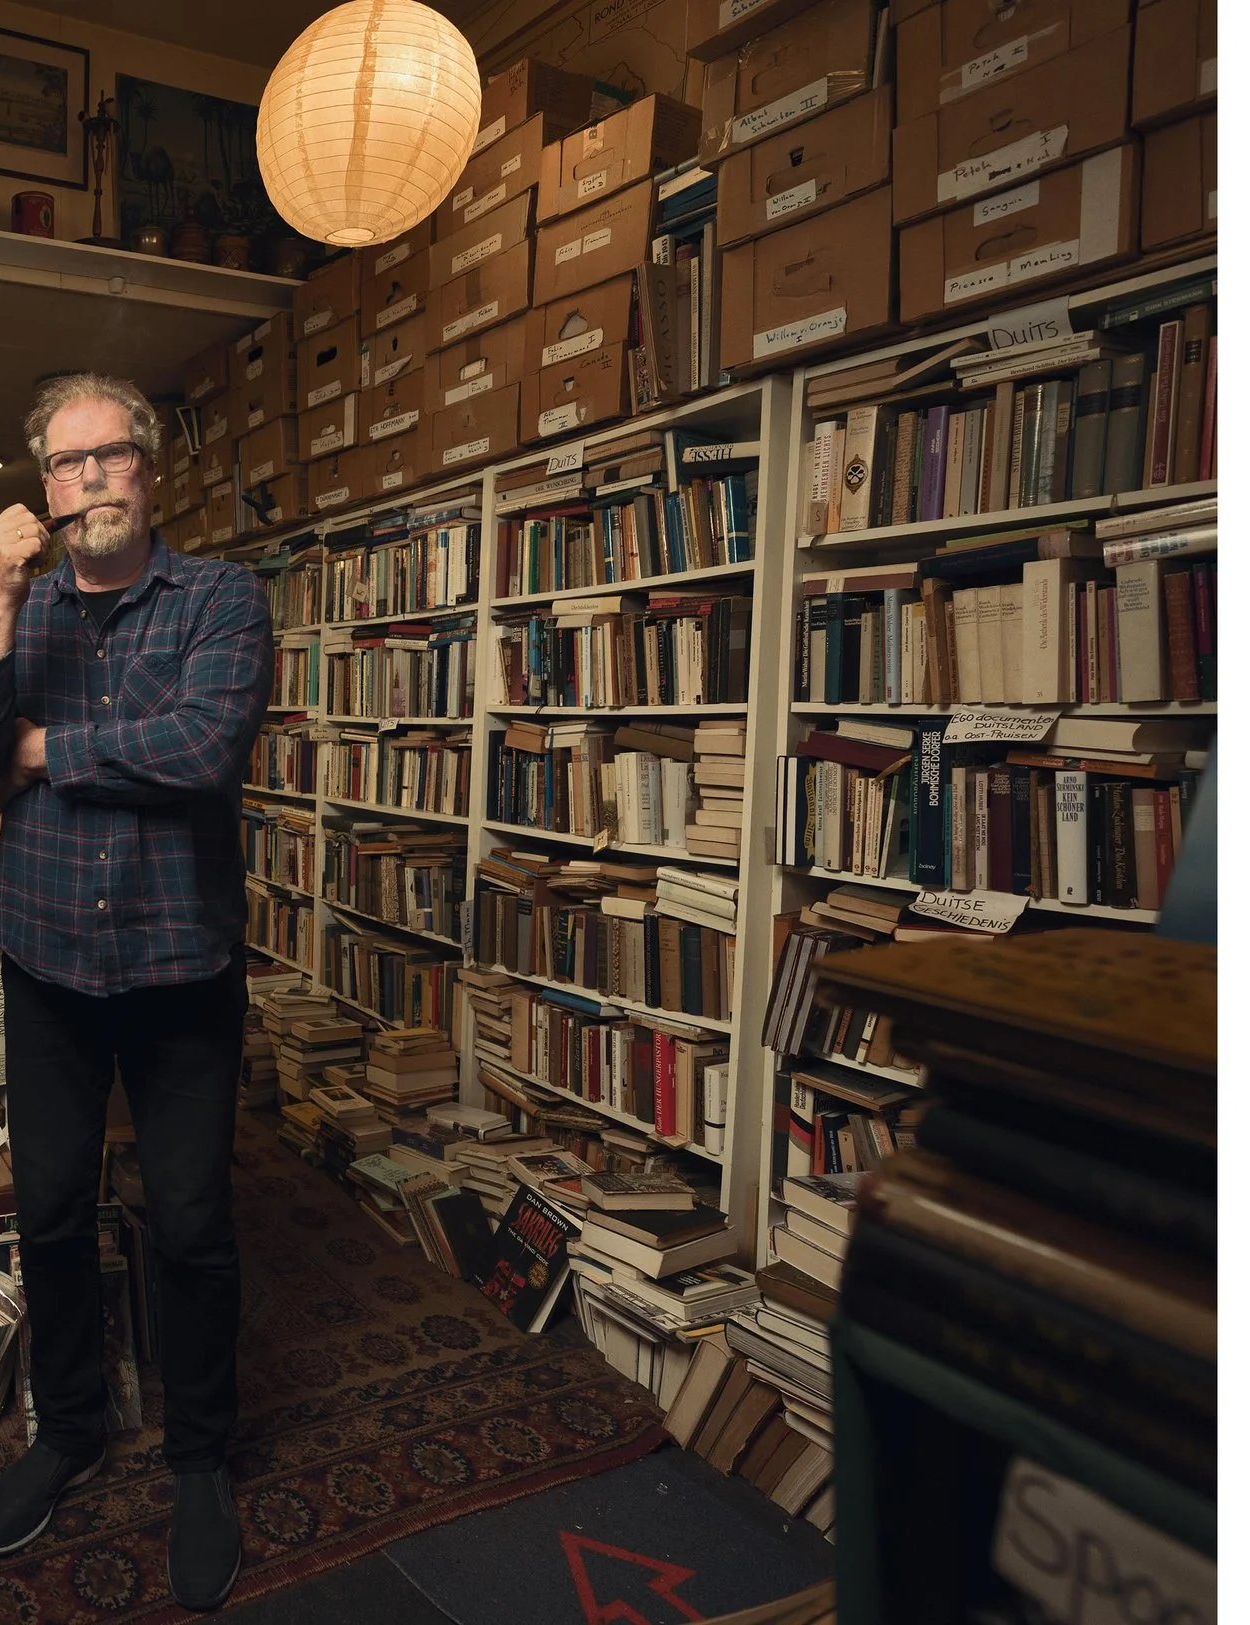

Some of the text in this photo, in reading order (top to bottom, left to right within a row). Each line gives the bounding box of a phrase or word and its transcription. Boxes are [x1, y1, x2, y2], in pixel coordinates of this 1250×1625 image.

[655, 279, 673, 385] PICASSO
[951, 713, 974, 724] EGO
[922, 730, 931, 754] SERKE
[1063, 776, 1078, 784] ARNO
[1061, 792, 1079, 802] KEIN
[1061, 811, 1080, 822] LAND
[654, 1033, 663, 1097] HUNGERPASTOR
[525, 1193, 569, 1232] DAN BROWN
